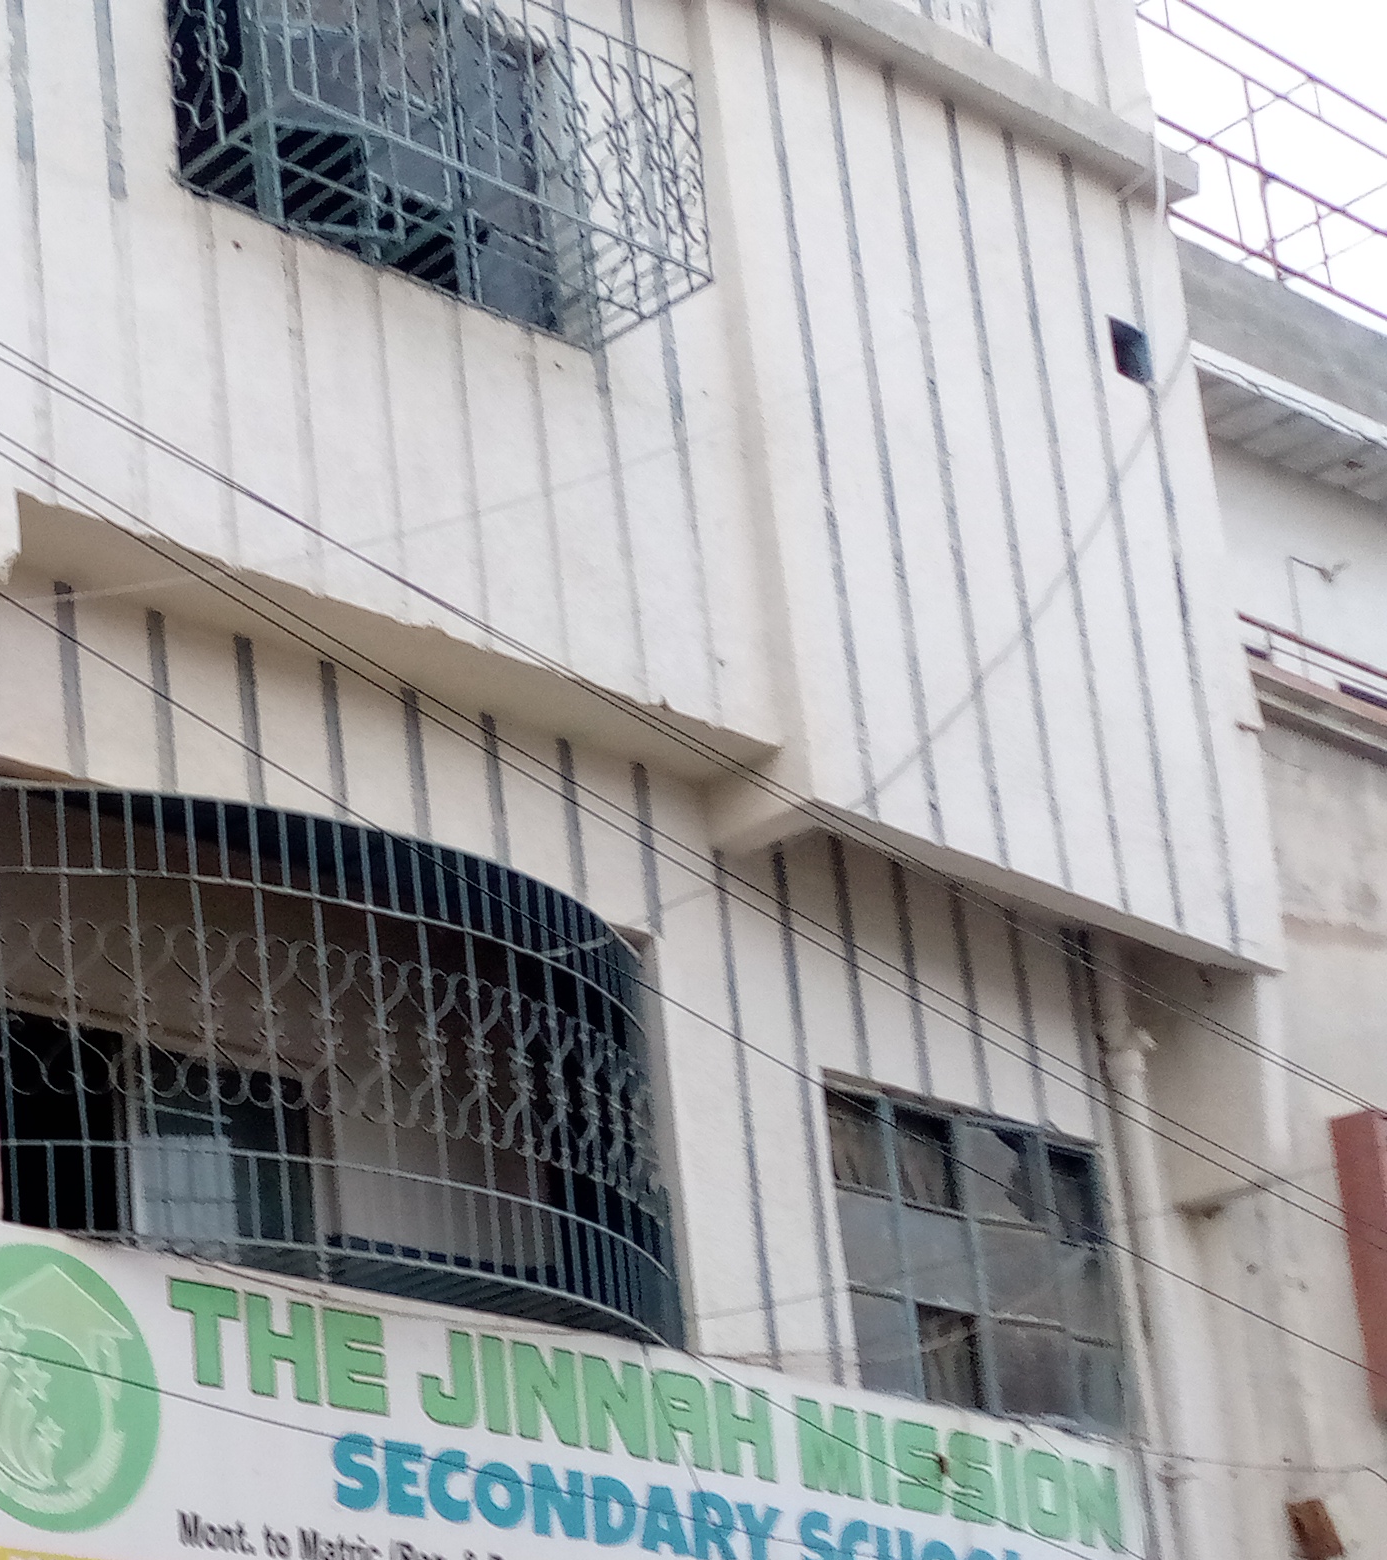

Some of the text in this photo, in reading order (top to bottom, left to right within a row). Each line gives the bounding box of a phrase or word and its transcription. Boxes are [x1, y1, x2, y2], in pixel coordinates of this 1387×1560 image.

[169, 1277, 1125, 1554] THE JINNAH MISSION
[176, 1509, 257, 1557] Mont.
[262, 1523, 292, 1560] to
